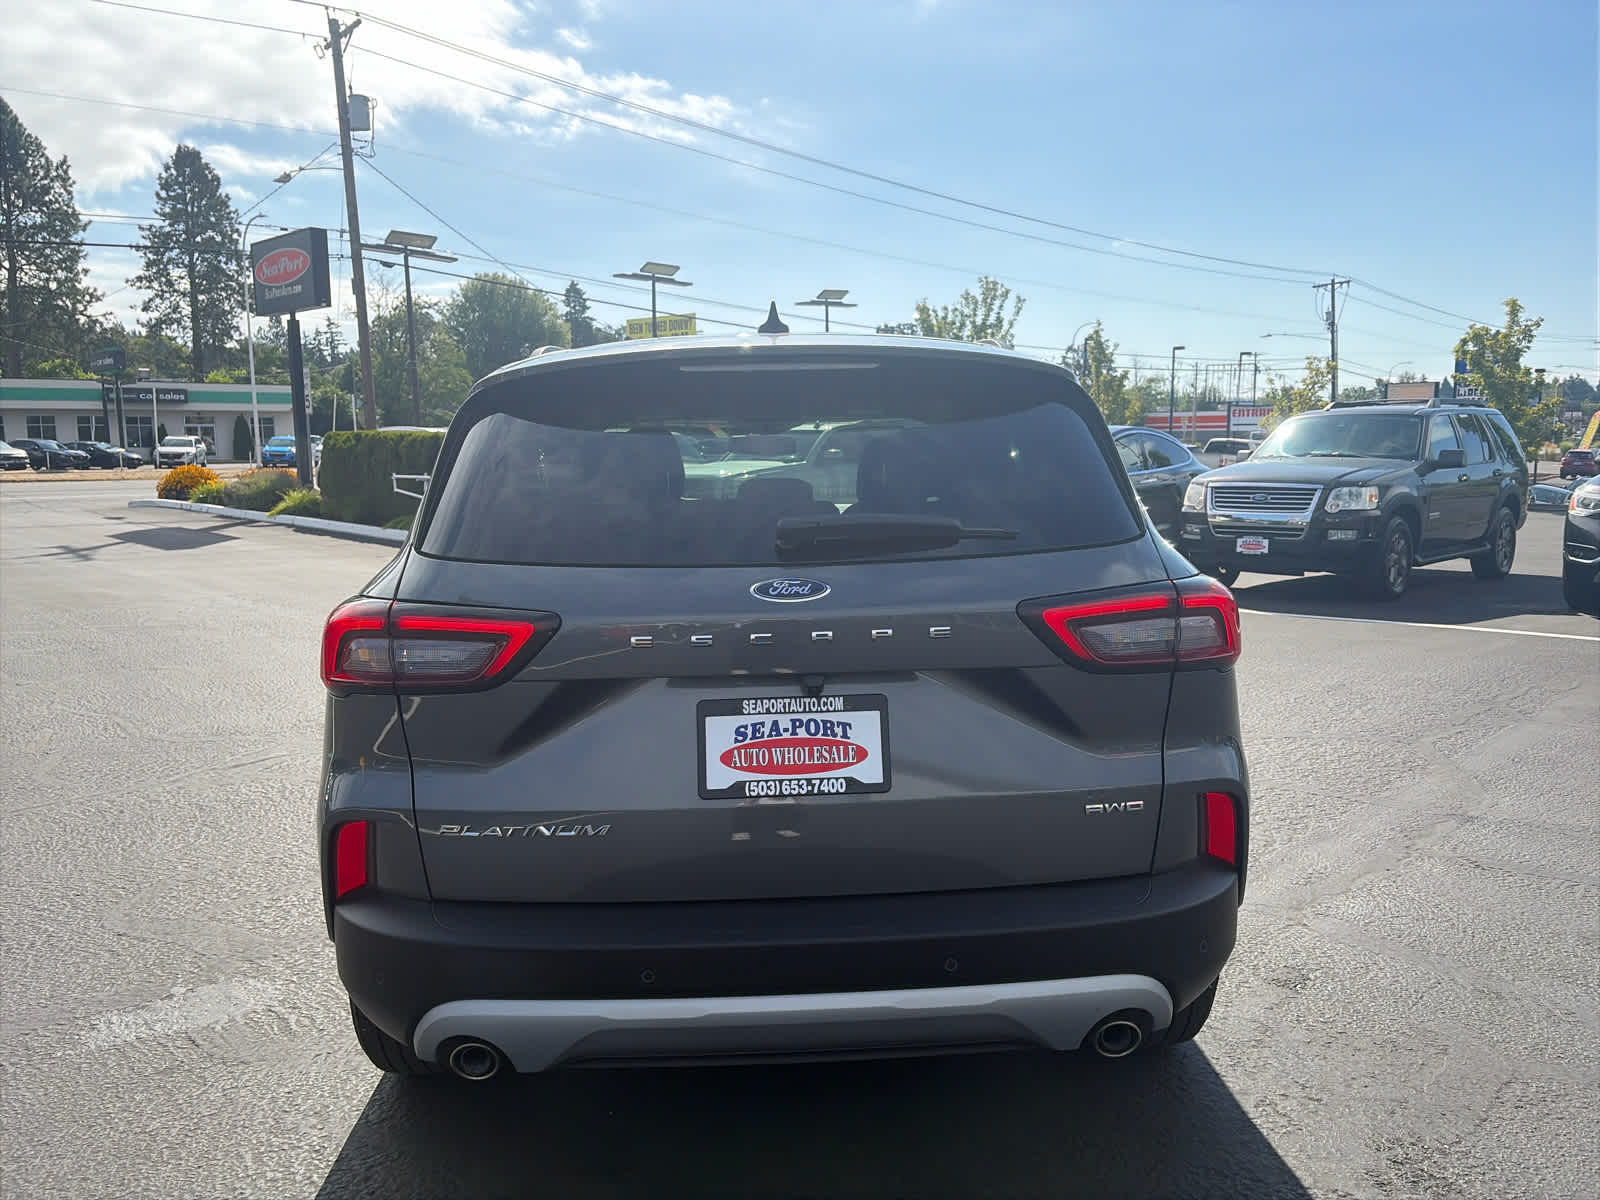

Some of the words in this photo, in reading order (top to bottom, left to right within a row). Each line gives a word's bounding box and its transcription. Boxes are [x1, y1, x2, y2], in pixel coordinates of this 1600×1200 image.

[768, 580, 812, 595] Ford
[630, 625, 952, 648] ESCAPE
[742, 696, 845, 714] SEAPORTAUTO.COM
[733, 717, 853, 745] SEA-PORT
[730, 747, 769, 768] AUTO
[771, 745, 858, 766] WHOLESALE
[438, 823, 612, 838] PLATINUM
